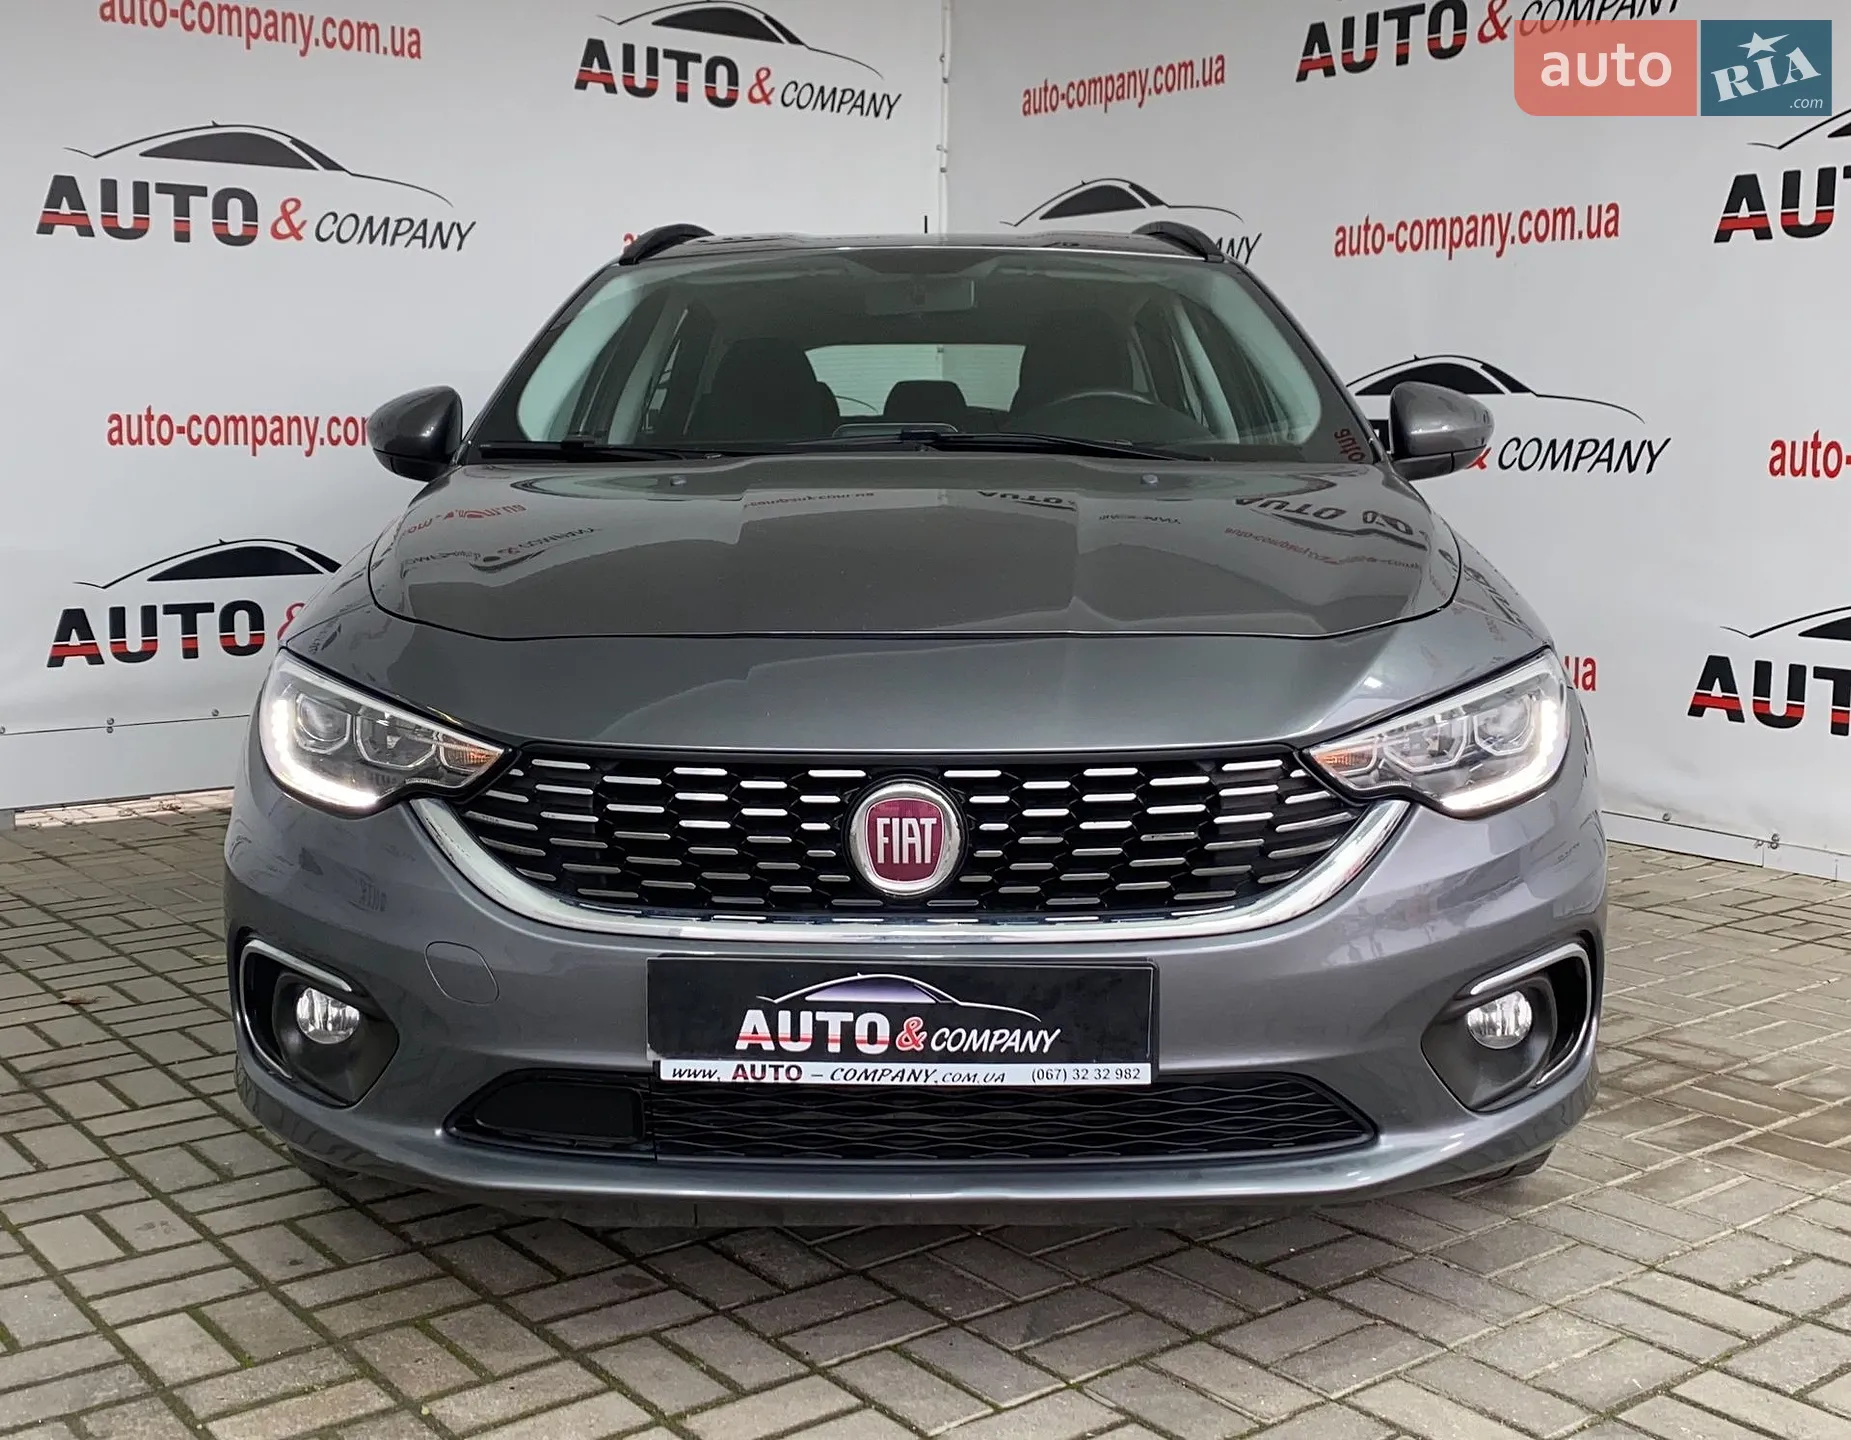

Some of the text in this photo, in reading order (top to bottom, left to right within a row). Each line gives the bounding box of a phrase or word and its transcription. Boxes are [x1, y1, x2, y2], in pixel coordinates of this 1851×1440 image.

[98, 0, 422, 60] auto-company.com.ua
[1295, 0, 1468, 83] AUTO
[1476, 0, 1513, 45] &
[574, 38, 902, 120] AUTO & COMPANY
[1022, 53, 1225, 116] auto-company.com.ua
[35, 174, 477, 252] AUTO & COMPANY
[1333, 201, 1621, 260] auto-company.com.ua
[1713, 164, 1851, 244] AU
[1497, 436, 1672, 475] COMPANY
[46, 600, 266, 668] AUTO
[876, 817, 938, 864] FIAT
[735, 1009, 1062, 1055] AUTO & COMPANY
[731, 1063, 803, 1082] AUTO
[1031, 1068, 1141, 1083] (067) 32 32 982
